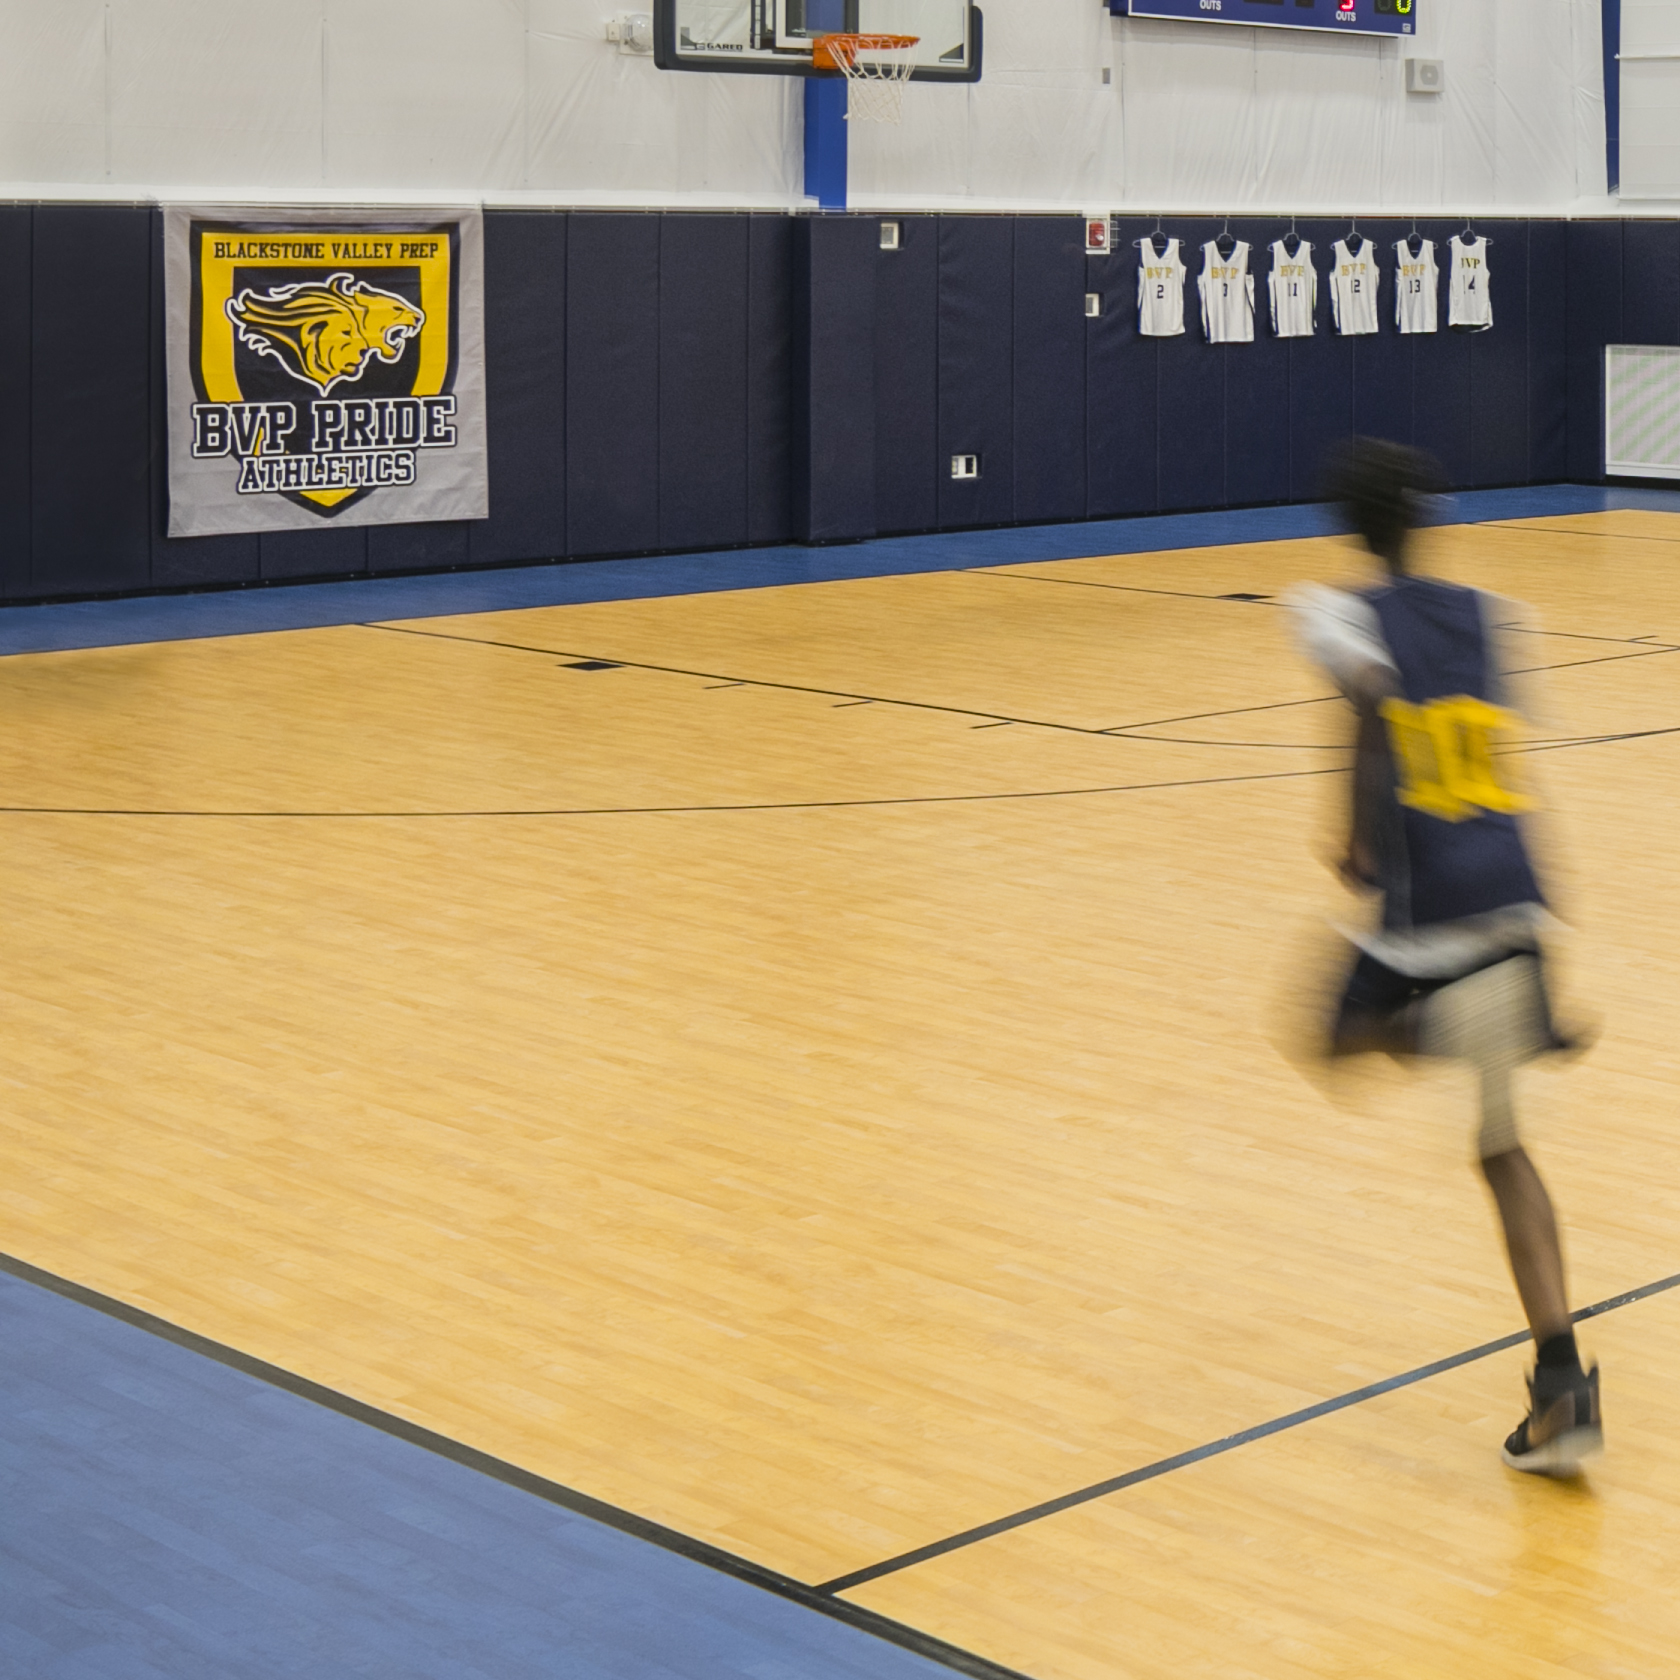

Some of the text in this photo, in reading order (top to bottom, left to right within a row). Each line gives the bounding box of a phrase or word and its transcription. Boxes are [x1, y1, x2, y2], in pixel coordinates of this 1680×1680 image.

[1199, 0, 1222, 11] OUTS
[1335, 10, 1357, 22] OUTS
[213, 241, 439, 260] BLACKSTONE VALLEY PREP
[1145, 266, 1174, 280] BVP
[1156, 284, 1165, 299] 2
[1350, 279, 1361, 294] 12
[1408, 279, 1421, 294] 13
[192, 396, 457, 458] BVP PRIDE
[238, 450, 417, 494] ATHLETICS
